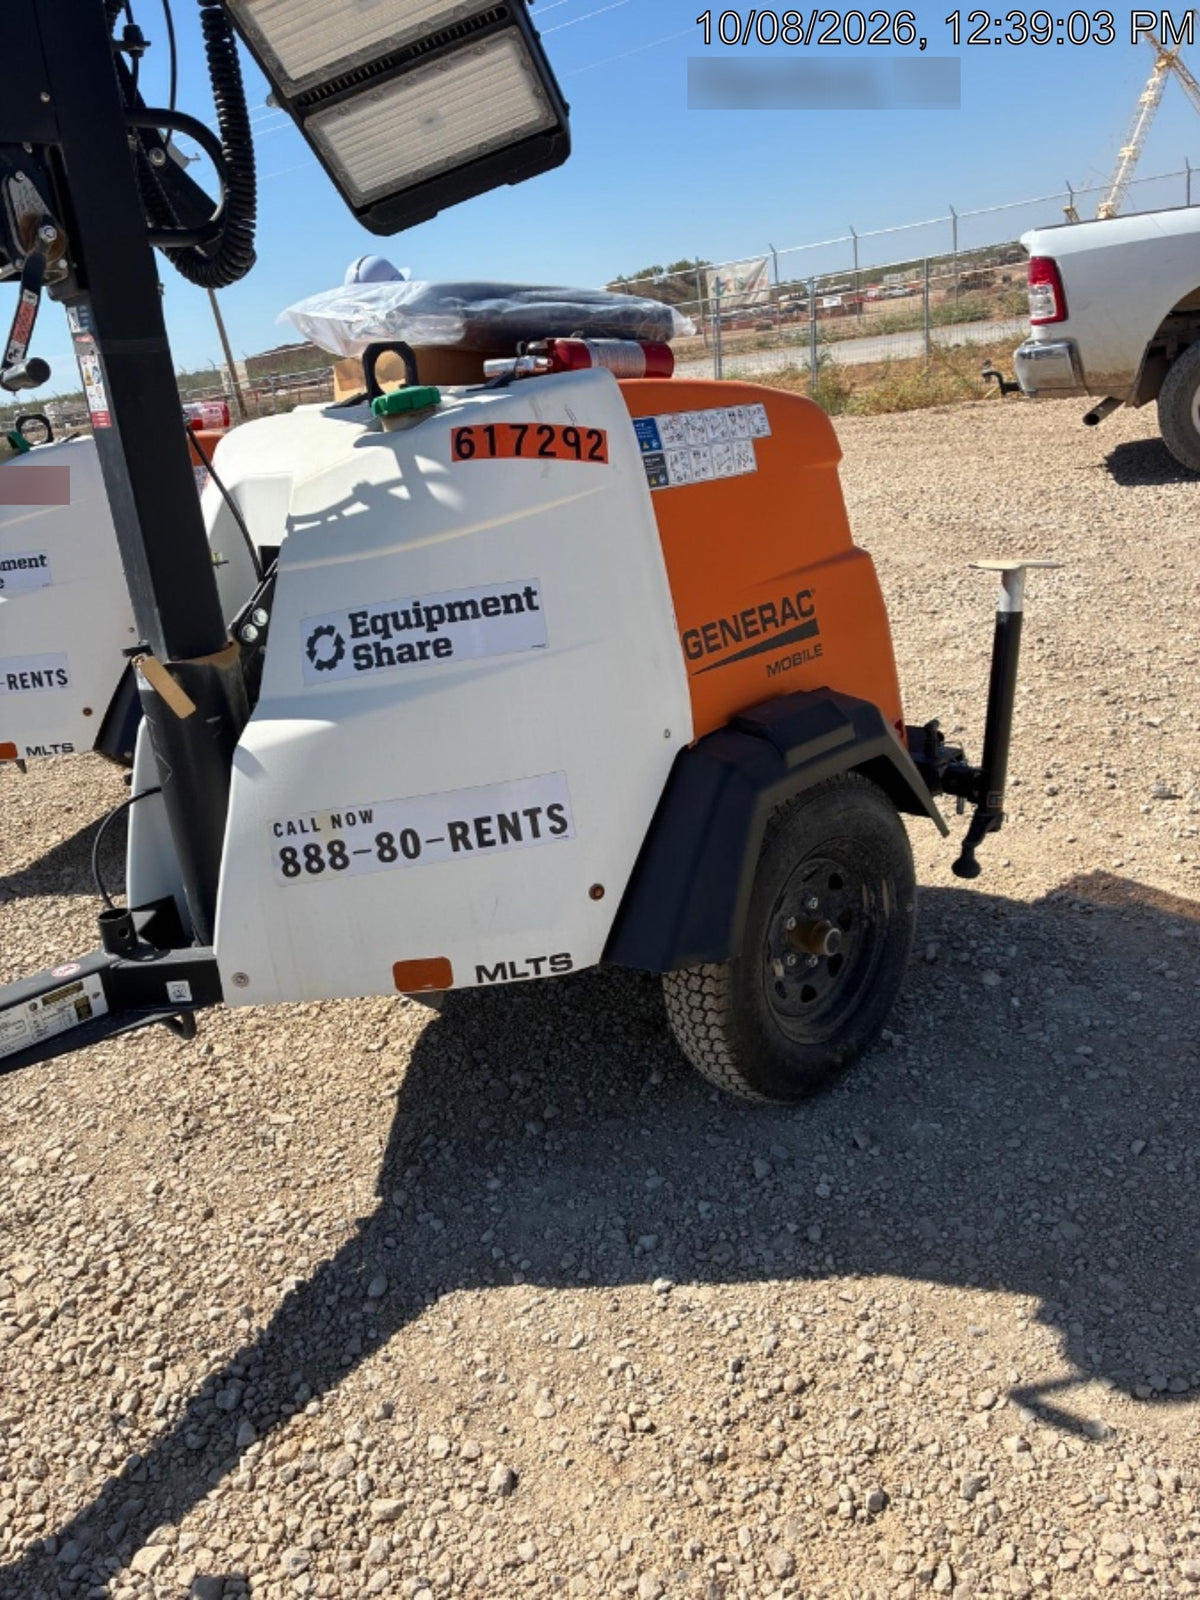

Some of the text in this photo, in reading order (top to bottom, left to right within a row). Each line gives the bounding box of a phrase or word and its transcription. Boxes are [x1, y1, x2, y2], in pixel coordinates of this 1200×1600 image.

[455, 424, 605, 461] 617292
[348, 586, 540, 640] Equipment
[682, 589, 815, 660] GENERAC
[353, 637, 453, 671] Share
[766, 643, 823, 678] MOBILE
[26, 743, 74, 757] MLTS
[273, 809, 374, 838] CALL NOW
[279, 803, 569, 878] 888-80-RENTS
[475, 953, 573, 983] MLTS
